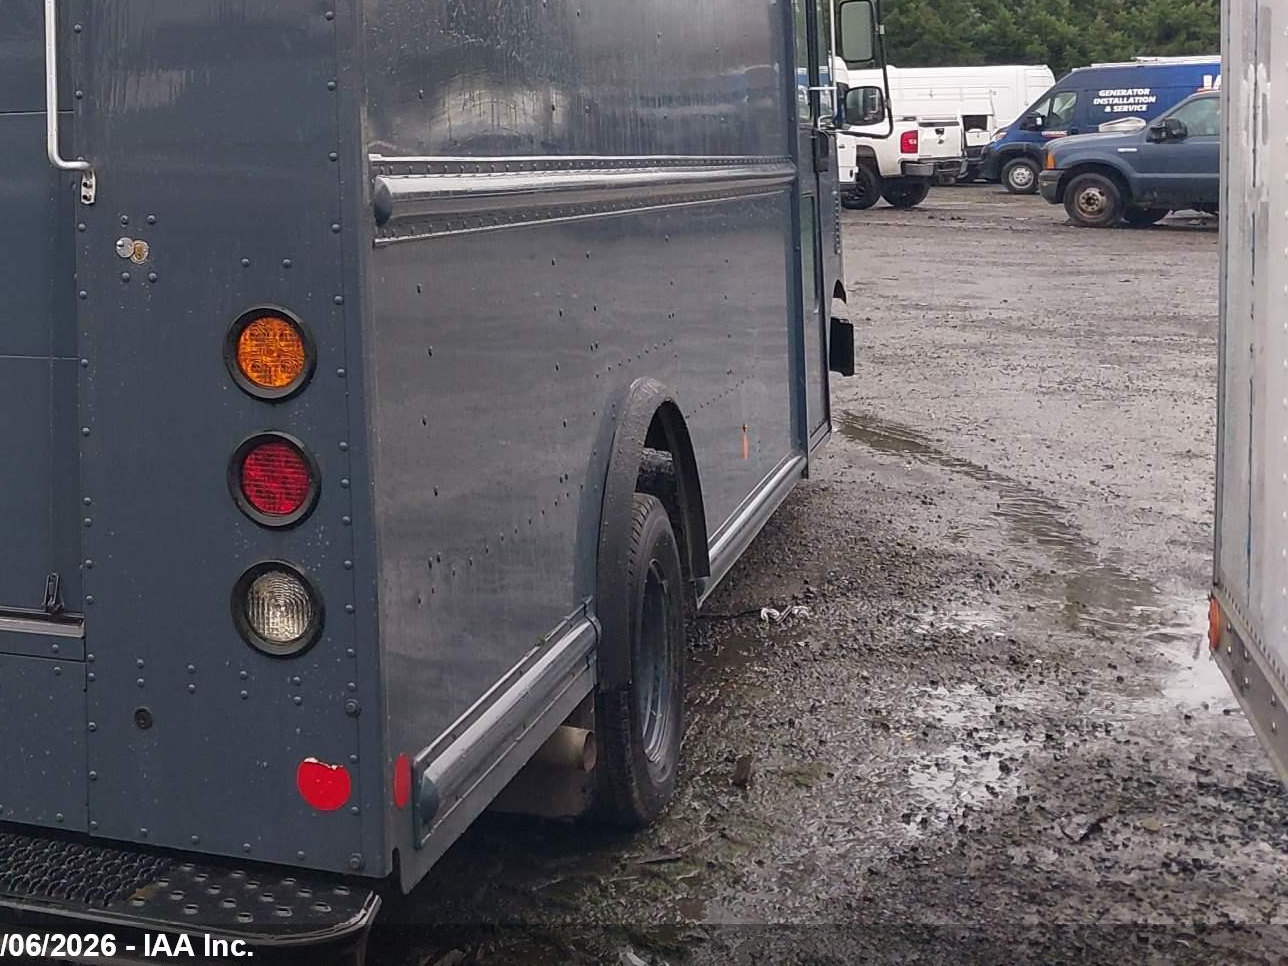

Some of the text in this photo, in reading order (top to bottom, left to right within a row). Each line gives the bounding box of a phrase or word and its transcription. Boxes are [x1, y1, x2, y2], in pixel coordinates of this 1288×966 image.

[1098, 88, 1150, 97] GENERATOR
[1093, 96, 1157, 105] INSTALLATION
[1112, 104, 1148, 112] SERVICE
